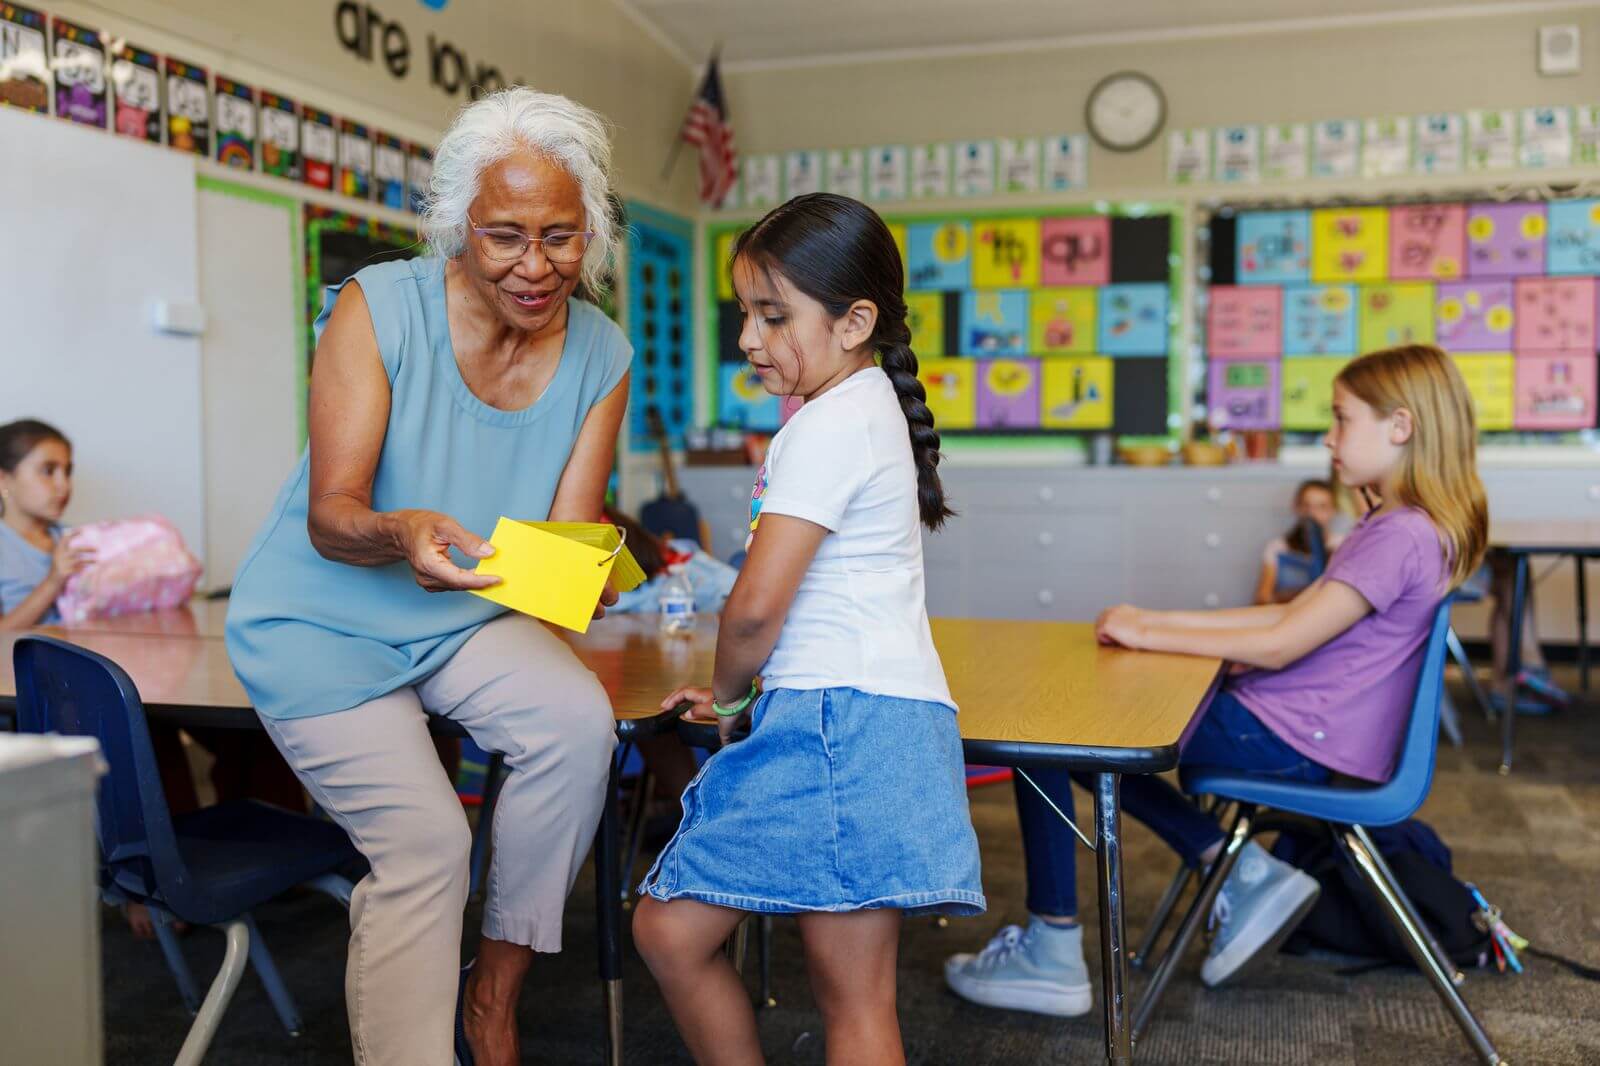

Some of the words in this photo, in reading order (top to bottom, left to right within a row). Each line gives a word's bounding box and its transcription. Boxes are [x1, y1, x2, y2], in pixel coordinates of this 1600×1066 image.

[335, 1, 410, 79] are
[426, 32, 525, 100] lov
[1042, 234, 1102, 275] qu
